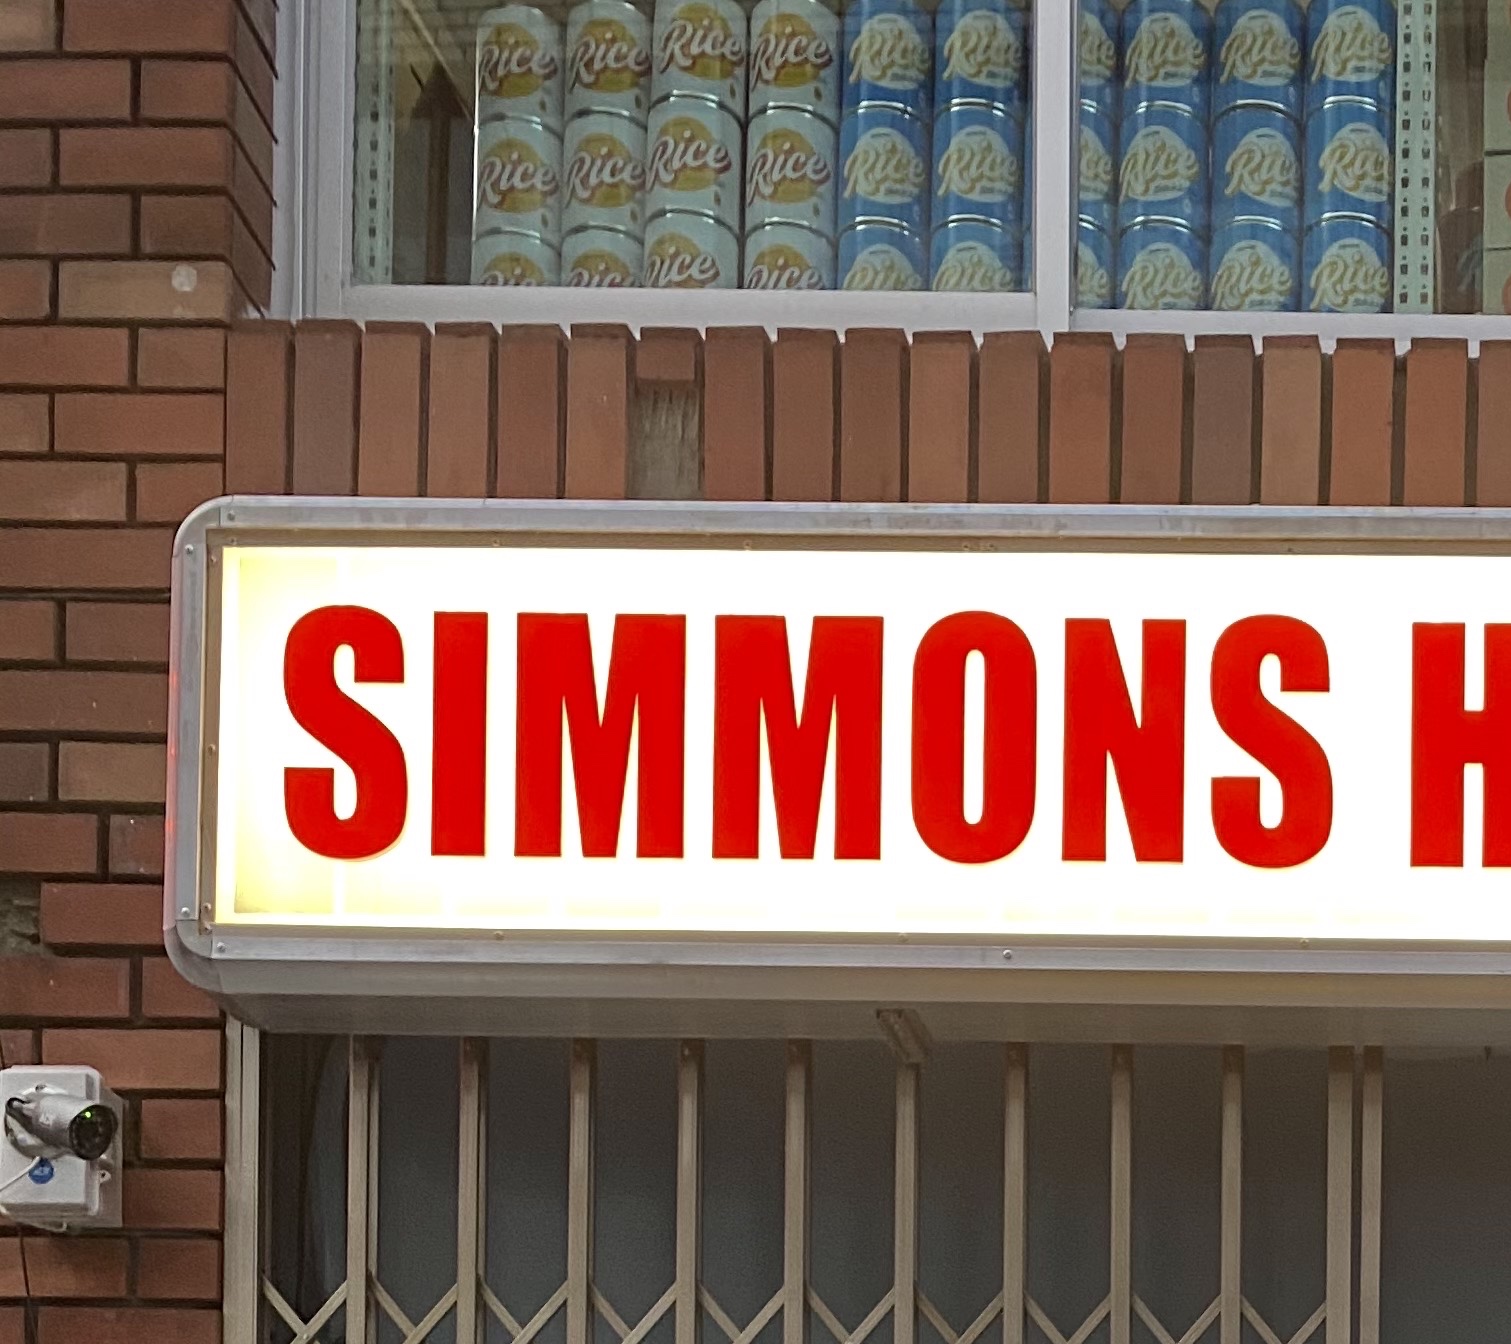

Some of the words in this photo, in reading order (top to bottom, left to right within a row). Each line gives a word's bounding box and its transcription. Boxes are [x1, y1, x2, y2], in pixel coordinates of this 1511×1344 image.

[478, 36, 558, 92] Rice
[569, 30, 650, 94] Rice
[660, 18, 744, 74] Rice
[751, 24, 833, 90] Rice
[1124, 22, 1207, 90] Rice
[1219, 22, 1301, 84] Rice
[1311, 20, 1391, 84] Rice
[478, 150, 558, 211] Rice
[564, 146, 648, 209] Rice
[650, 129, 732, 191] Rice
[747, 141, 832, 208] Rice
[1118, 138, 1200, 205] Rice
[1121, 254, 1203, 310] Rice
[1211, 249, 1293, 310] Rice
[1310, 250, 1390, 311] Rice
[282, 604, 1335, 869] SIMMONS
